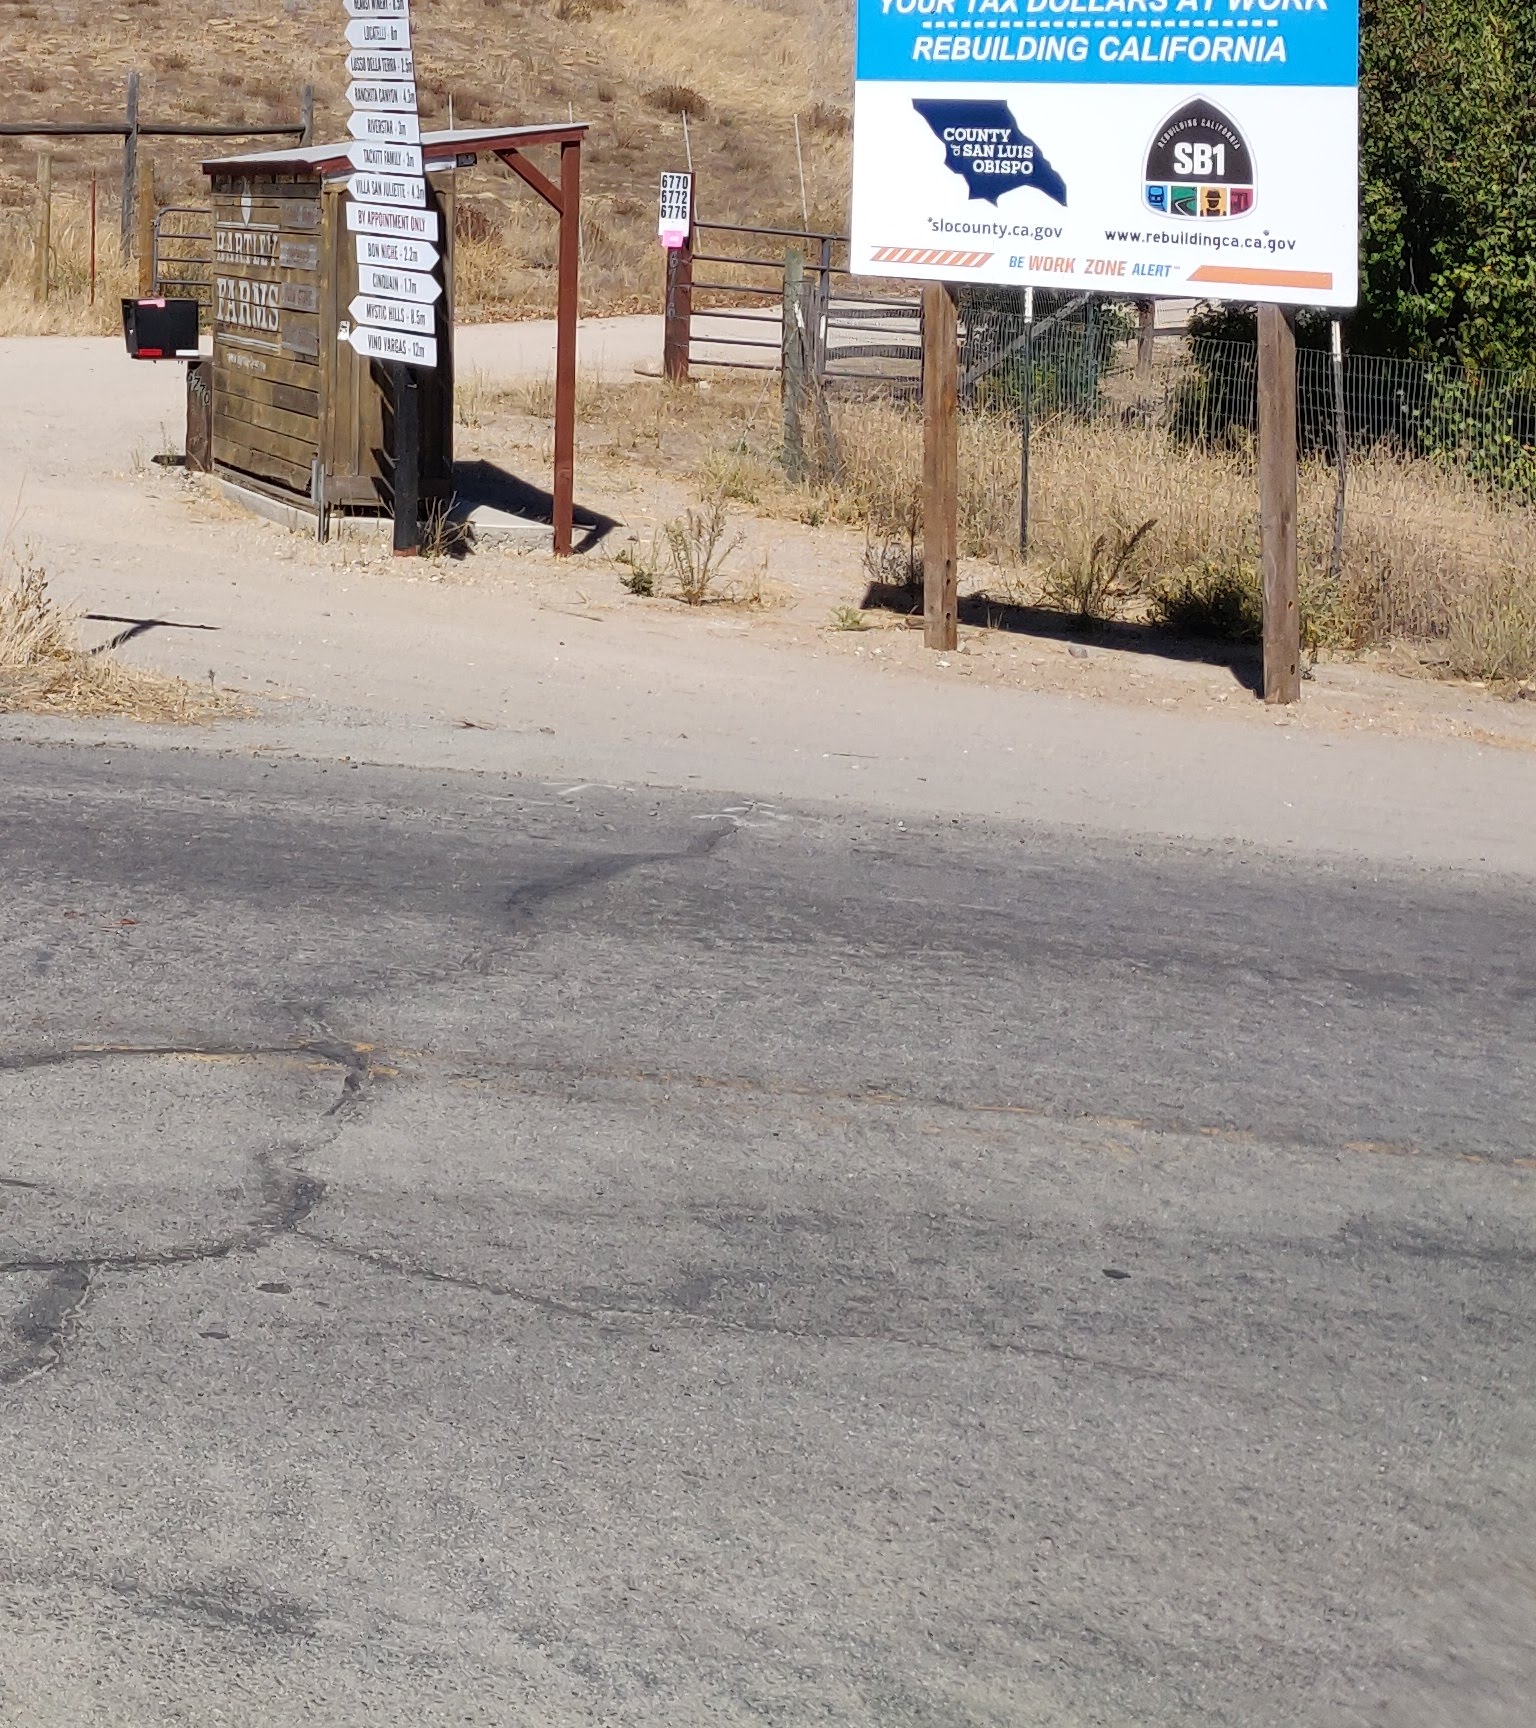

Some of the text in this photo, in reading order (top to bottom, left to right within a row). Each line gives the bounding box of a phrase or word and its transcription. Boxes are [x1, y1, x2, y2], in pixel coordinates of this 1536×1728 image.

[912, 35, 1287, 63] REBUILDING CALIFORNIA
[943, 127, 1011, 143] COUNTY
[1157, 118, 1242, 150] REBUILDING CALIFORNIA
[384, 151, 401, 166] FAMILY
[962, 144, 995, 157] SAN
[997, 145, 1034, 158] LUIS
[1173, 141, 1225, 176] SB1
[972, 159, 1034, 174] OBISPO
[355, 179, 370, 194] VILLA
[371, 180, 382, 196] SAN
[662, 175, 688, 190] 6770
[661, 190, 688, 205] 6772
[357, 209, 426, 232] BY APPOINTMENT ONLY
[660, 205, 687, 219] 6776
[932, 218, 1063, 241] slocounty.ca.gov
[367, 242, 380, 258] BON
[1104, 230, 1296, 253] www.rebuildingca.ca.gov
[1008, 255, 1025, 268] BE
[1028, 255, 1076, 274] WORK
[1083, 258, 1128, 277] ZONE
[216, 277, 279, 331] FARMS
[366, 303, 387, 321] MYSTIC
[388, 306, 405, 323] HILLS
[367, 334, 382, 352] VINO
[383, 336, 407, 355] VARGAS
